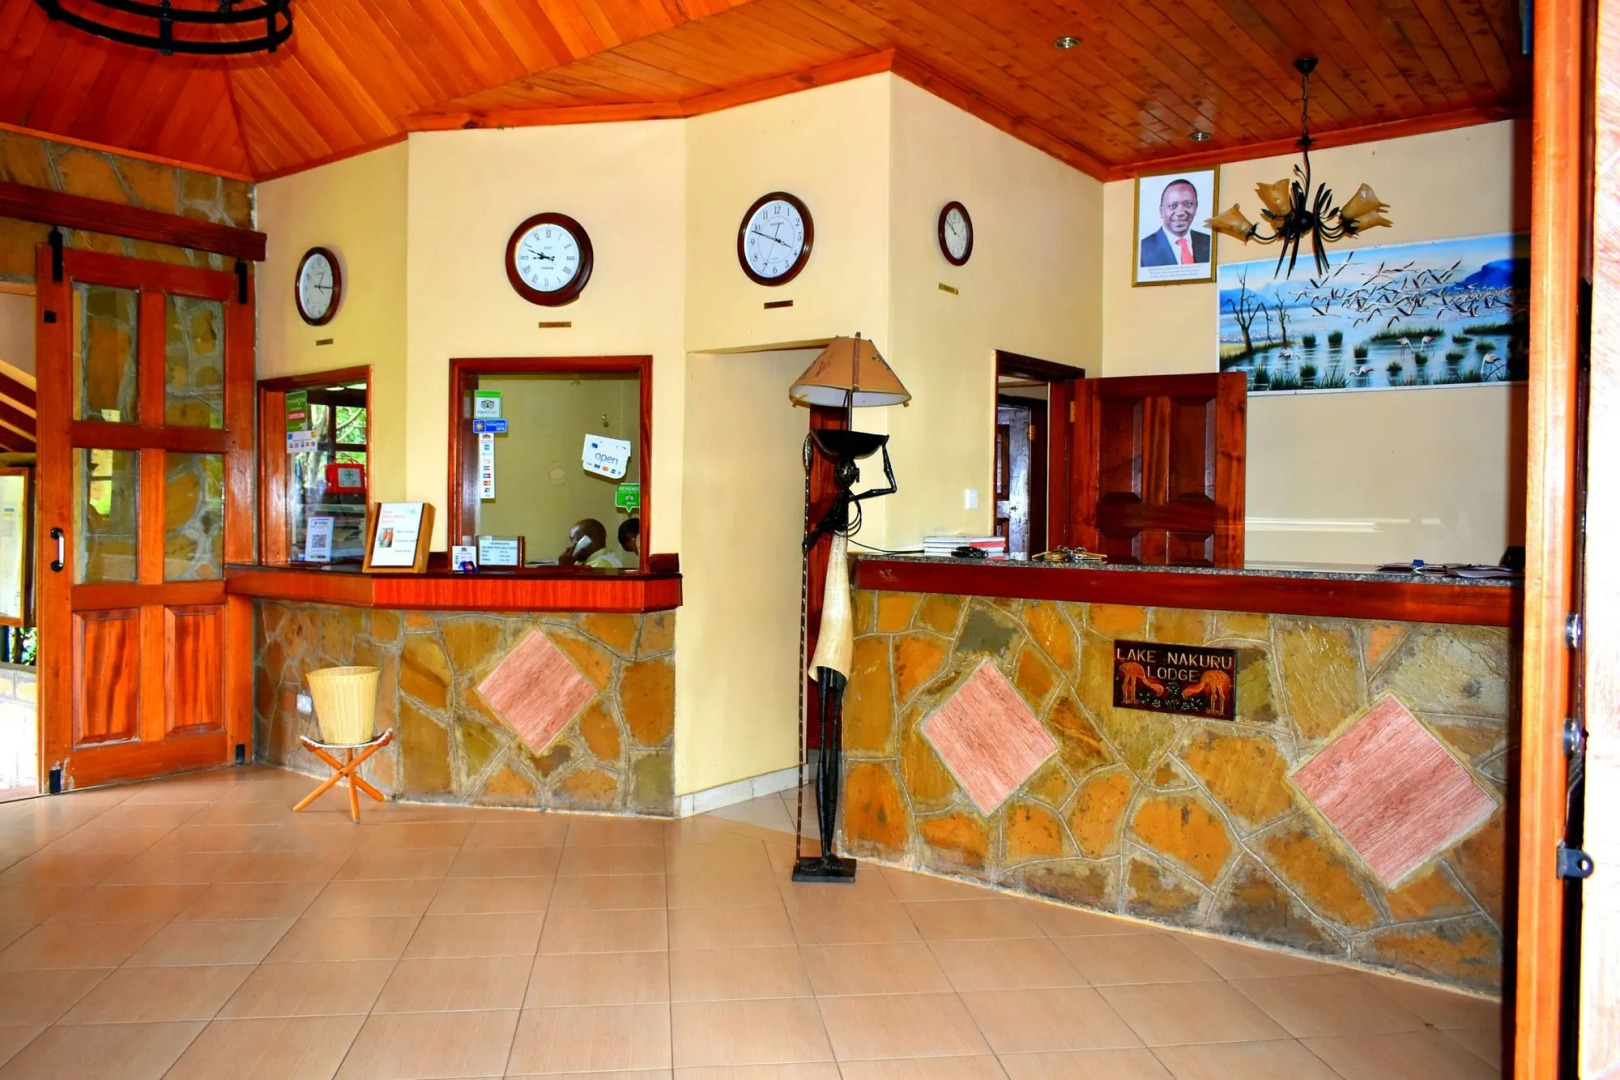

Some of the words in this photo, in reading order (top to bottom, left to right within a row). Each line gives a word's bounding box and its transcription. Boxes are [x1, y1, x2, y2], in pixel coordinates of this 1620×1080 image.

[774, 205, 781, 215] 12
[795, 218, 801, 227] 2
[762, 262, 768, 272] 7
[595, 452, 619, 465] open
[1116, 647, 1157, 662] LAKE
[1167, 651, 1232, 669] NAKURU
[1147, 665, 1199, 682] LODGE
